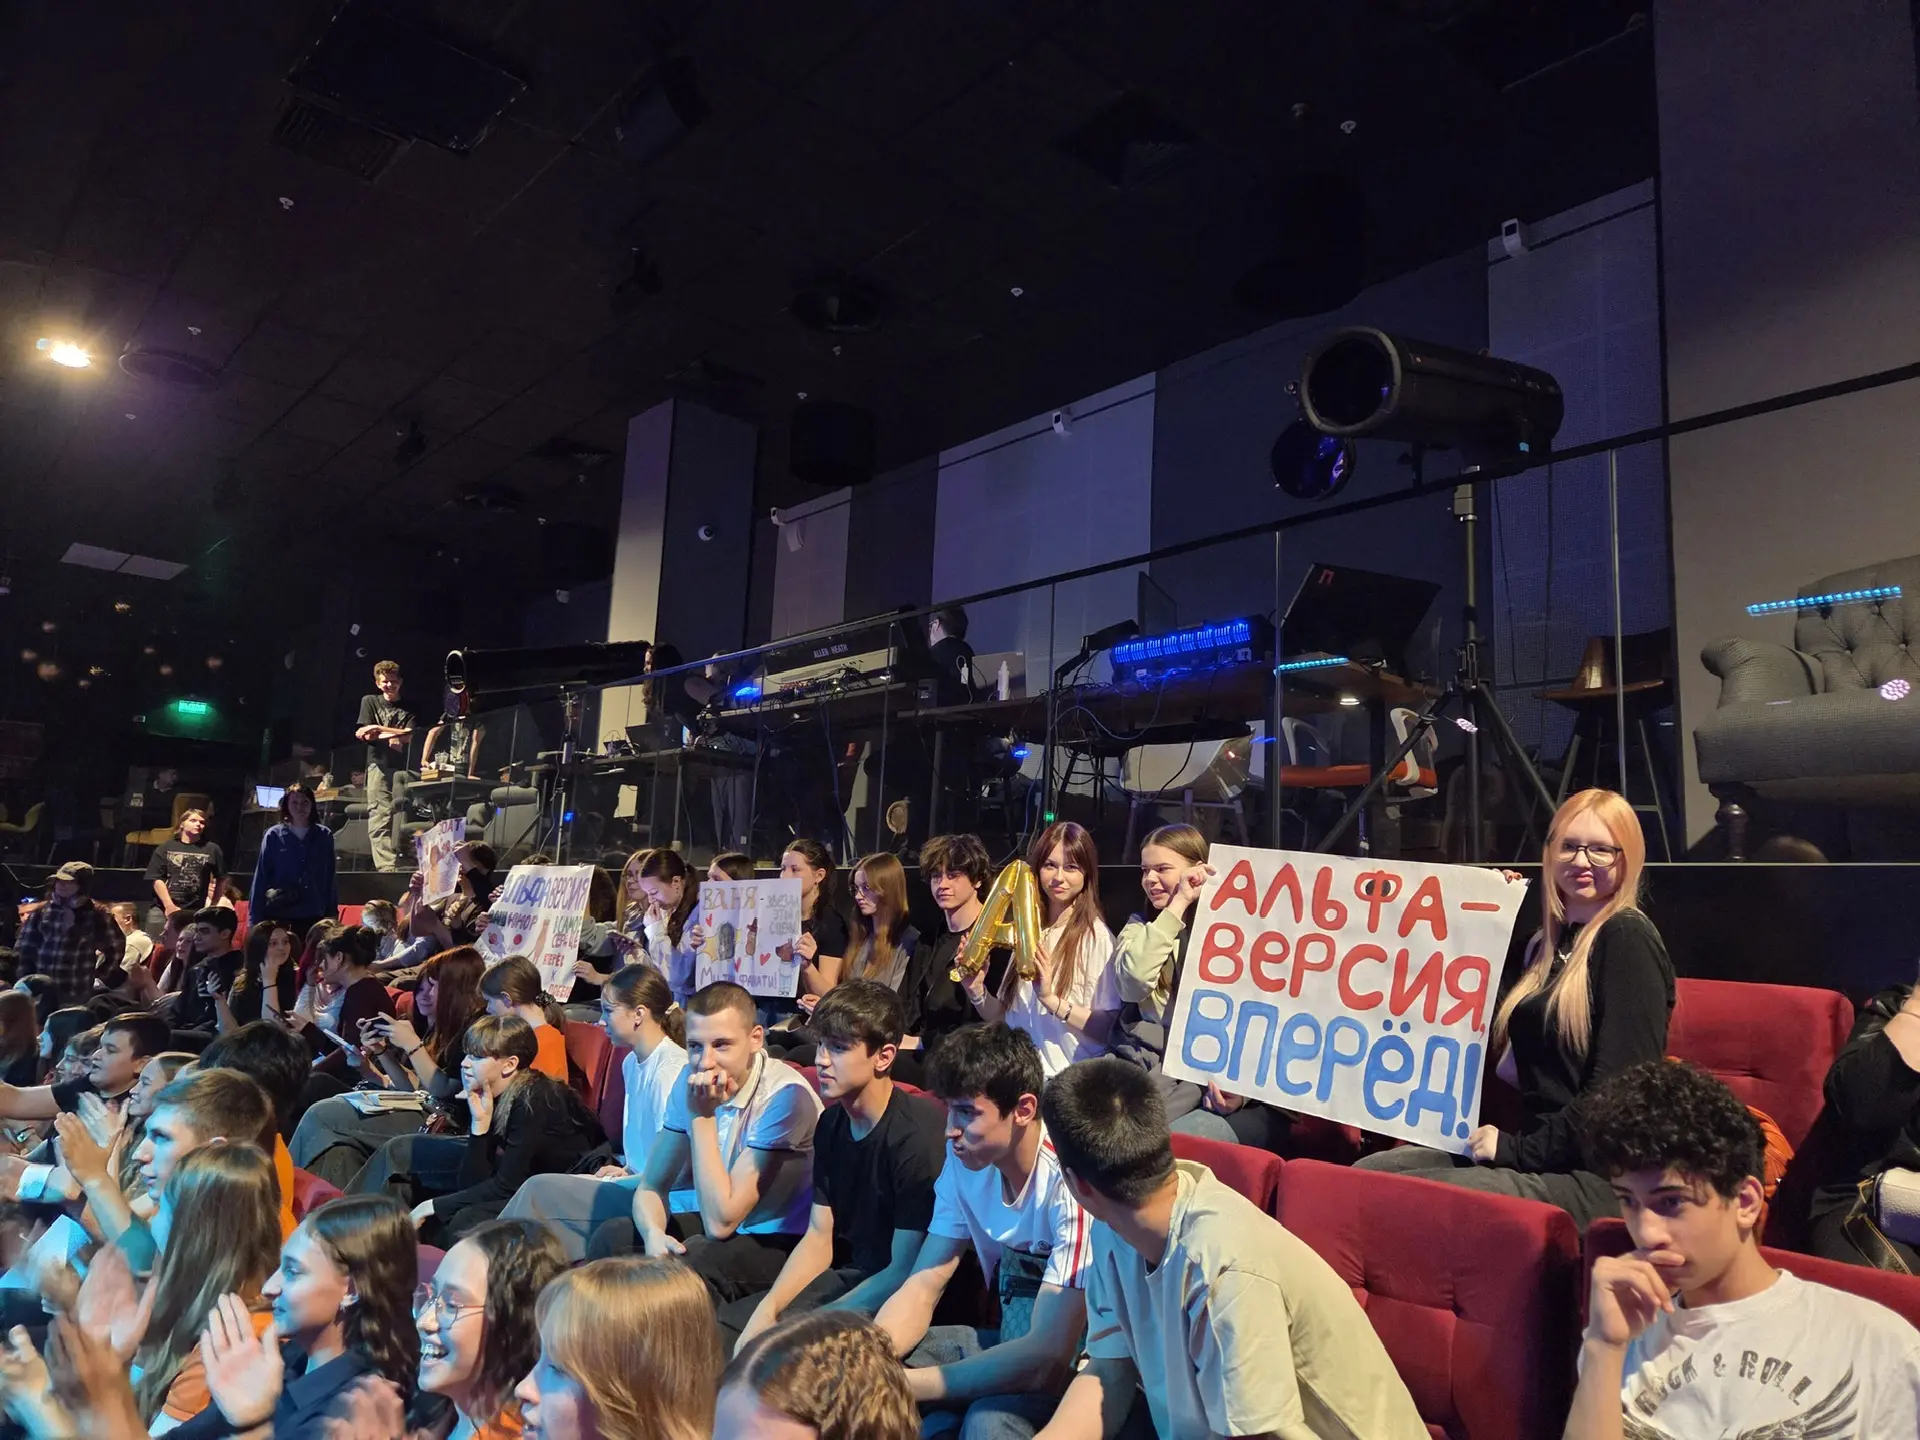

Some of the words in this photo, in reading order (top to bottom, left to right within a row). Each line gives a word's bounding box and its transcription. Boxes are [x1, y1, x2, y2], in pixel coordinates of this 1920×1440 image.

[830, 644, 848, 654] HEATH
[703, 886, 758, 910] ВАНЯ
[1739, 1350, 1813, 1406] ROLL
